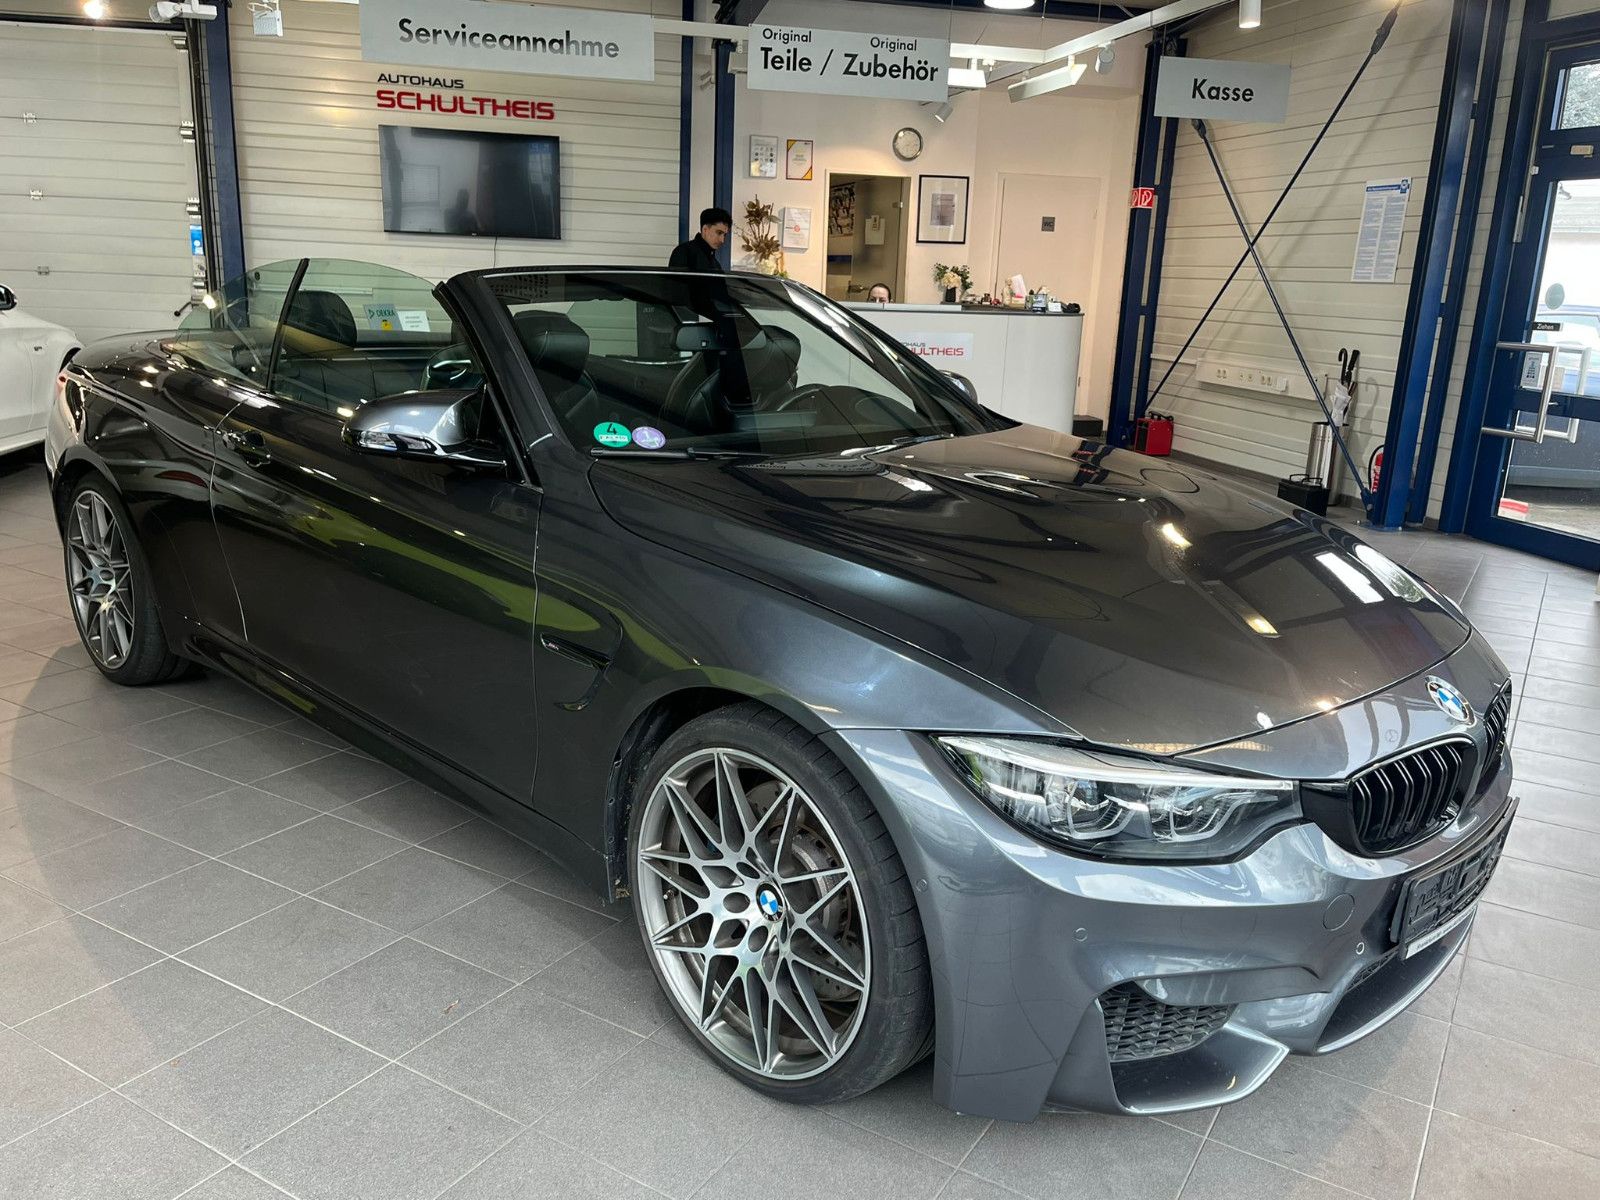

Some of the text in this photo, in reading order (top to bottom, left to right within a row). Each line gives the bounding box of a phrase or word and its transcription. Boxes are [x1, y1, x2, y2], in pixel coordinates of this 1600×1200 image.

[398, 18, 620, 58] Serviceannahme
[762, 28, 812, 44] Original
[870, 36, 917, 53] Original
[760, 46, 939, 81] Teile / Zubehör
[377, 73, 464, 89] AUTOHAUS
[1191, 78, 1254, 102] Kasse
[376, 90, 555, 120] SCHULTHEIS
[911, 347, 964, 356] ULTHEIS
[607, 423, 617, 434] 4
